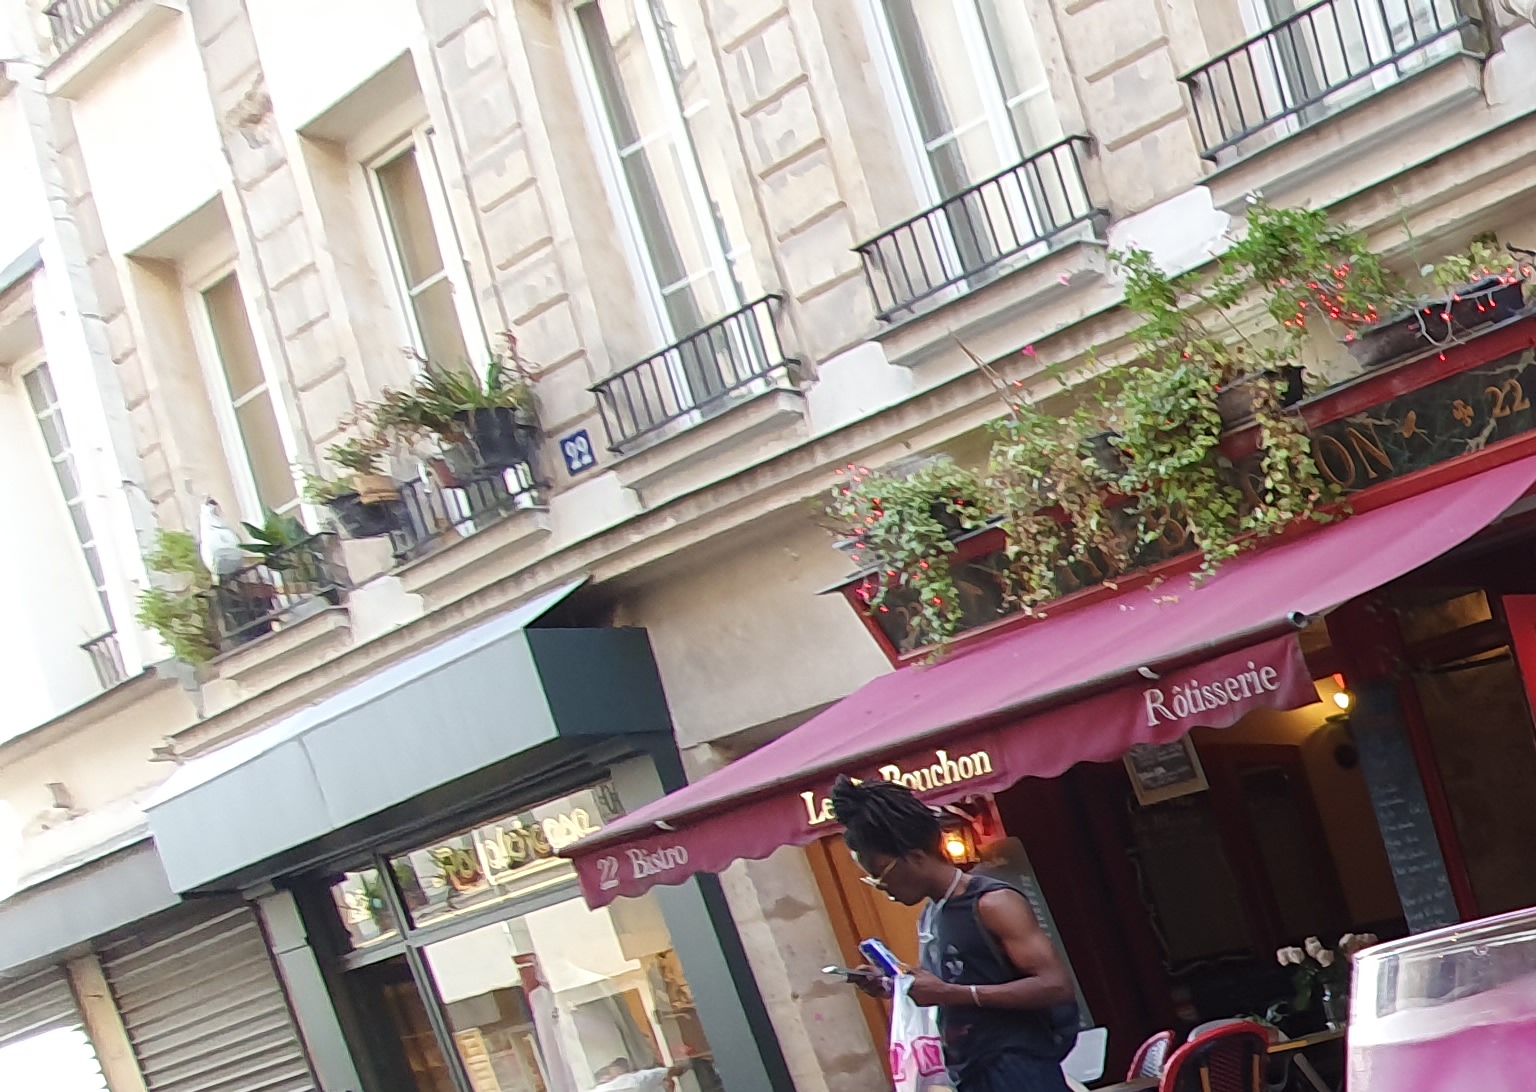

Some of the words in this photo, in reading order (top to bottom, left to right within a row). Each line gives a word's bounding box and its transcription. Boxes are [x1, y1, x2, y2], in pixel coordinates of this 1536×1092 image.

[1485, 379, 1531, 418] 22
[564, 435, 592, 470] 22
[1143, 661, 1280, 727] Rôtisserie
[597, 856, 620, 891] 22
[626, 845, 690, 879] Bistro
